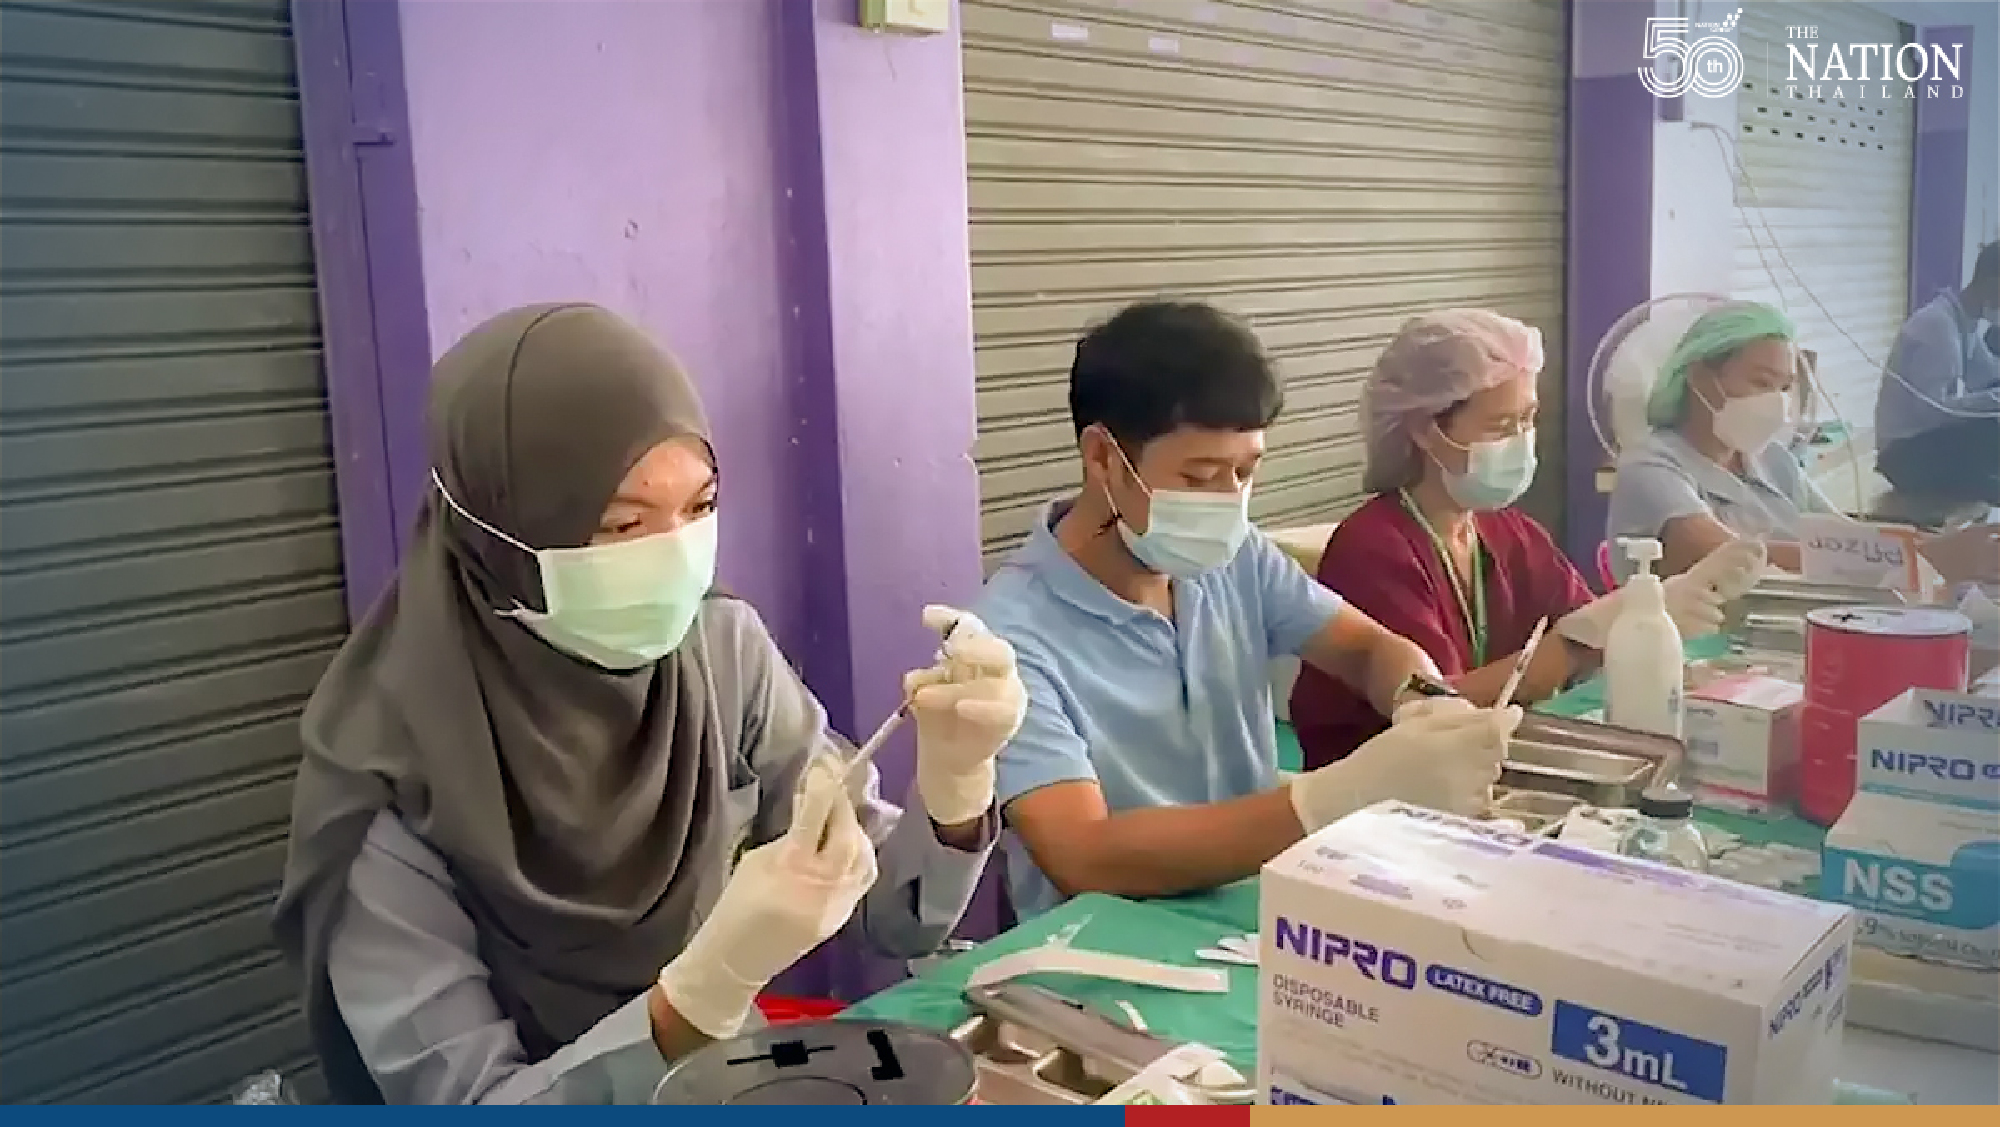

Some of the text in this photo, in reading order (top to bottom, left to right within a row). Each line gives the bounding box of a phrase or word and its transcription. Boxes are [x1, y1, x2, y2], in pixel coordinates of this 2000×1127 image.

[1923, 699, 2000, 729] NIPR
[1871, 749, 1976, 781] NIPRO
[1843, 857, 1954, 911] NSS
[1275, 914, 1534, 1010] NIPRO LATEX FREE
[1272, 973, 1379, 1023] DISPOSABLE
[1272, 990, 1344, 1028] SYRINGE
[1584, 1015, 1688, 1090] 3mL
[1552, 1067, 1635, 1105] WITHOUT
